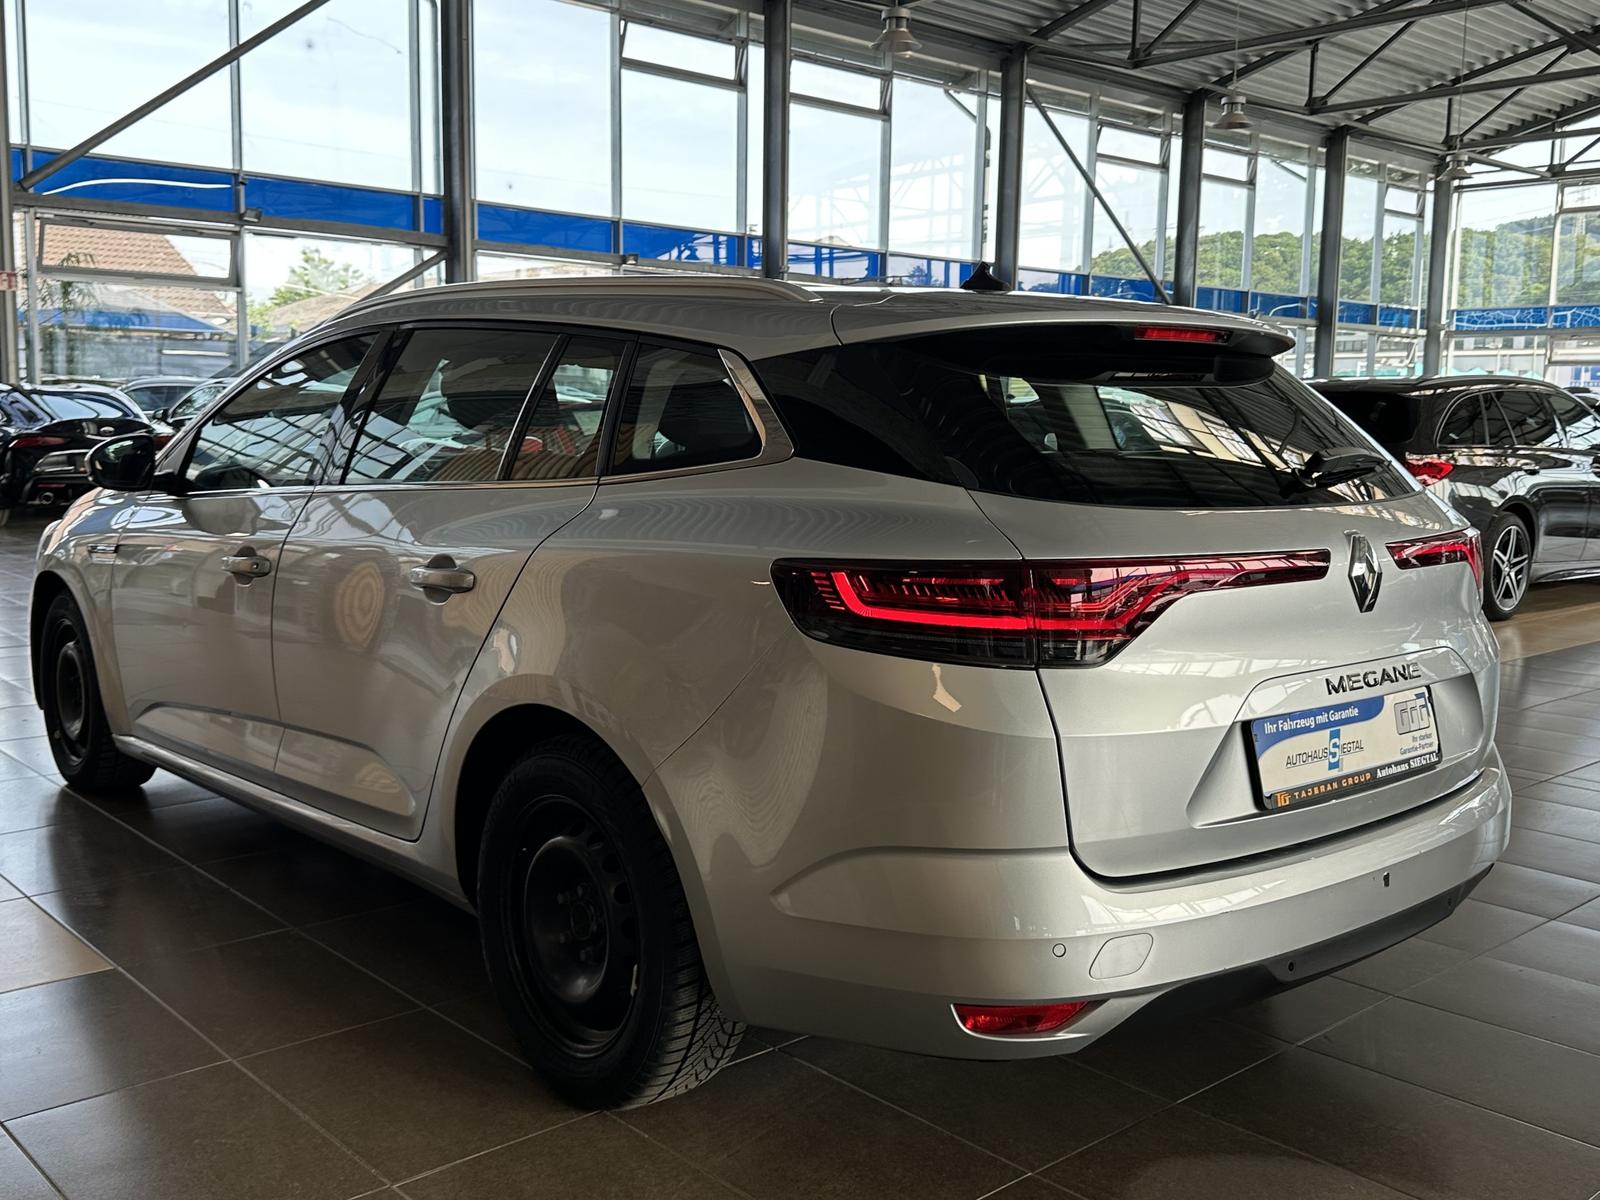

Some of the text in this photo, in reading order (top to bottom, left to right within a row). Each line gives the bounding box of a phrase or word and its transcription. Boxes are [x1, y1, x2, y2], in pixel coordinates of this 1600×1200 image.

[1325, 662, 1422, 695] MEGANE
[1264, 705, 1359, 735] Ihr Fahrzeug mit Garantie
[1286, 747, 1329, 767] AUTOHAUS
[1376, 753, 1439, 779] Autohaus SIEGTAL
[1342, 772, 1372, 787] GROUP
